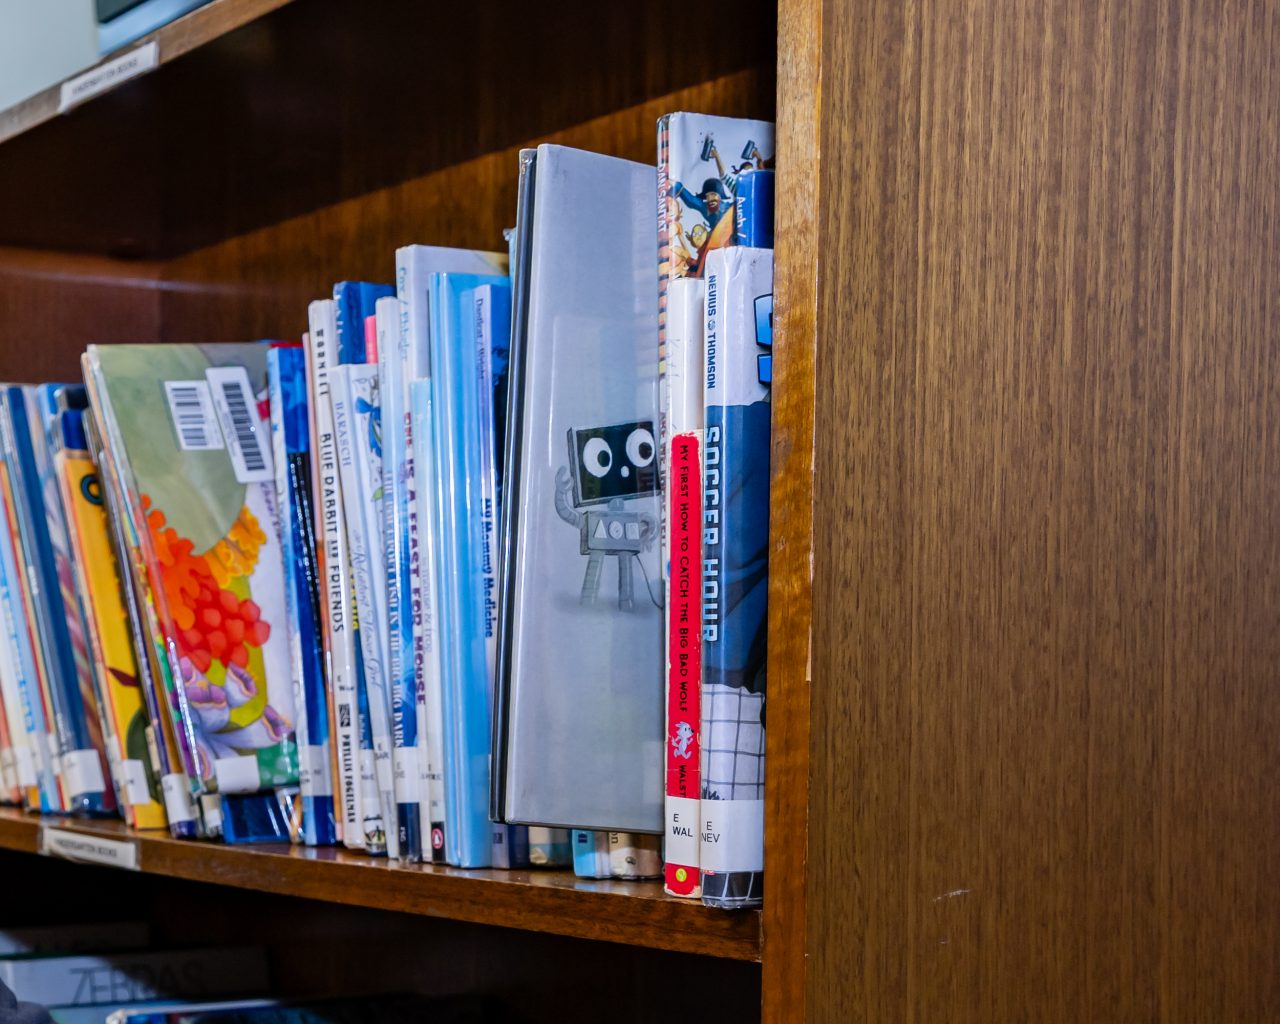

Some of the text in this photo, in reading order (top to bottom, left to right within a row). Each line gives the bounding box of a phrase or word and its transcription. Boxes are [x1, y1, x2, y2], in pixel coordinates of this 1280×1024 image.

[657, 163, 667, 233] DAN SANTAT
[707, 275, 717, 389] NEVIUS THOMSON
[321, 433, 334, 470] BLUE
[335, 402, 352, 467] BARASCH
[702, 426, 720, 643] SOCCER HOUR
[483, 577, 496, 638] Medicine
[678, 445, 689, 712] MY FIRST HOW TO CATCH THE BIG BAD WOLF
[672, 826, 693, 838] WAL
[673, 814, 679, 823] E
[701, 833, 720, 843] NEV
[706, 821, 712, 831] E
